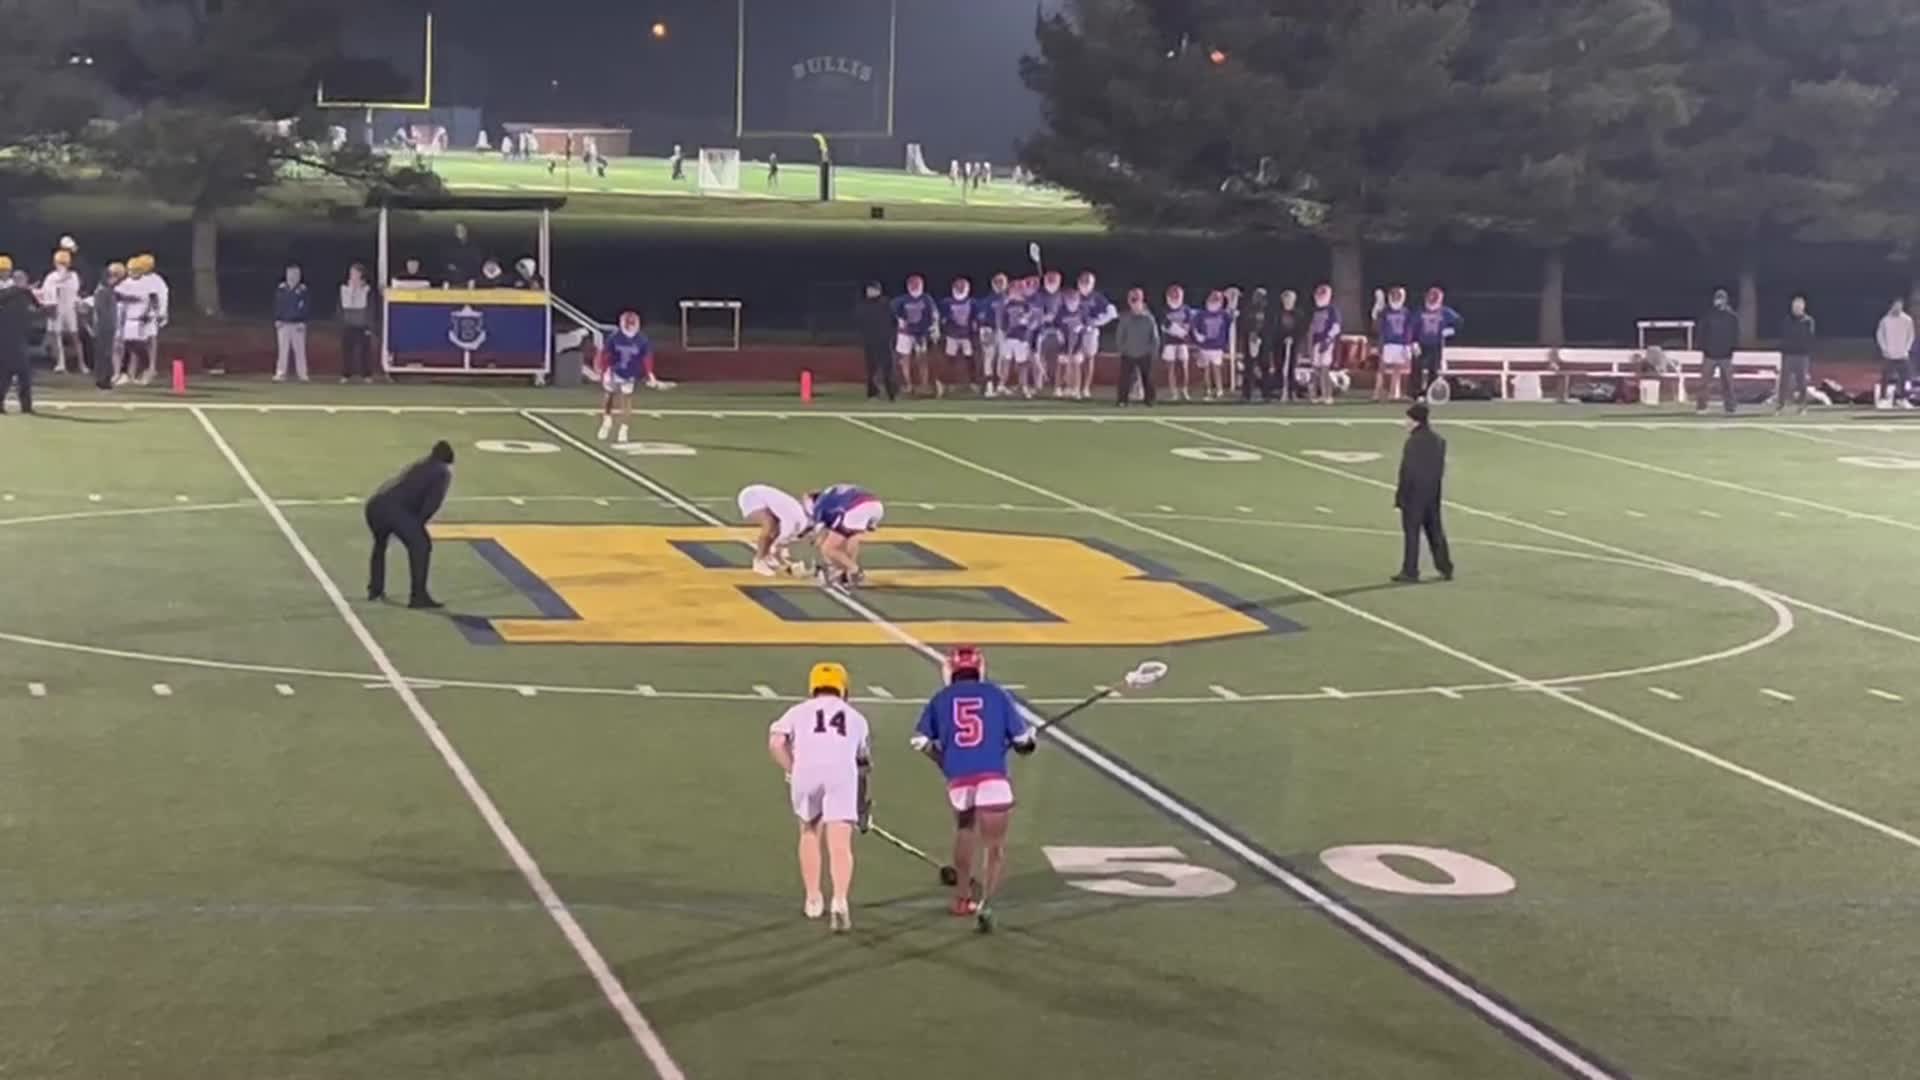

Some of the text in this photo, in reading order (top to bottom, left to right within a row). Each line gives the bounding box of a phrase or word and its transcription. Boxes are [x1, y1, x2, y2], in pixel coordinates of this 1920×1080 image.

[814, 709, 847, 736] 14
[953, 697, 983, 747] 5
[1041, 844, 1516, 897] 50
